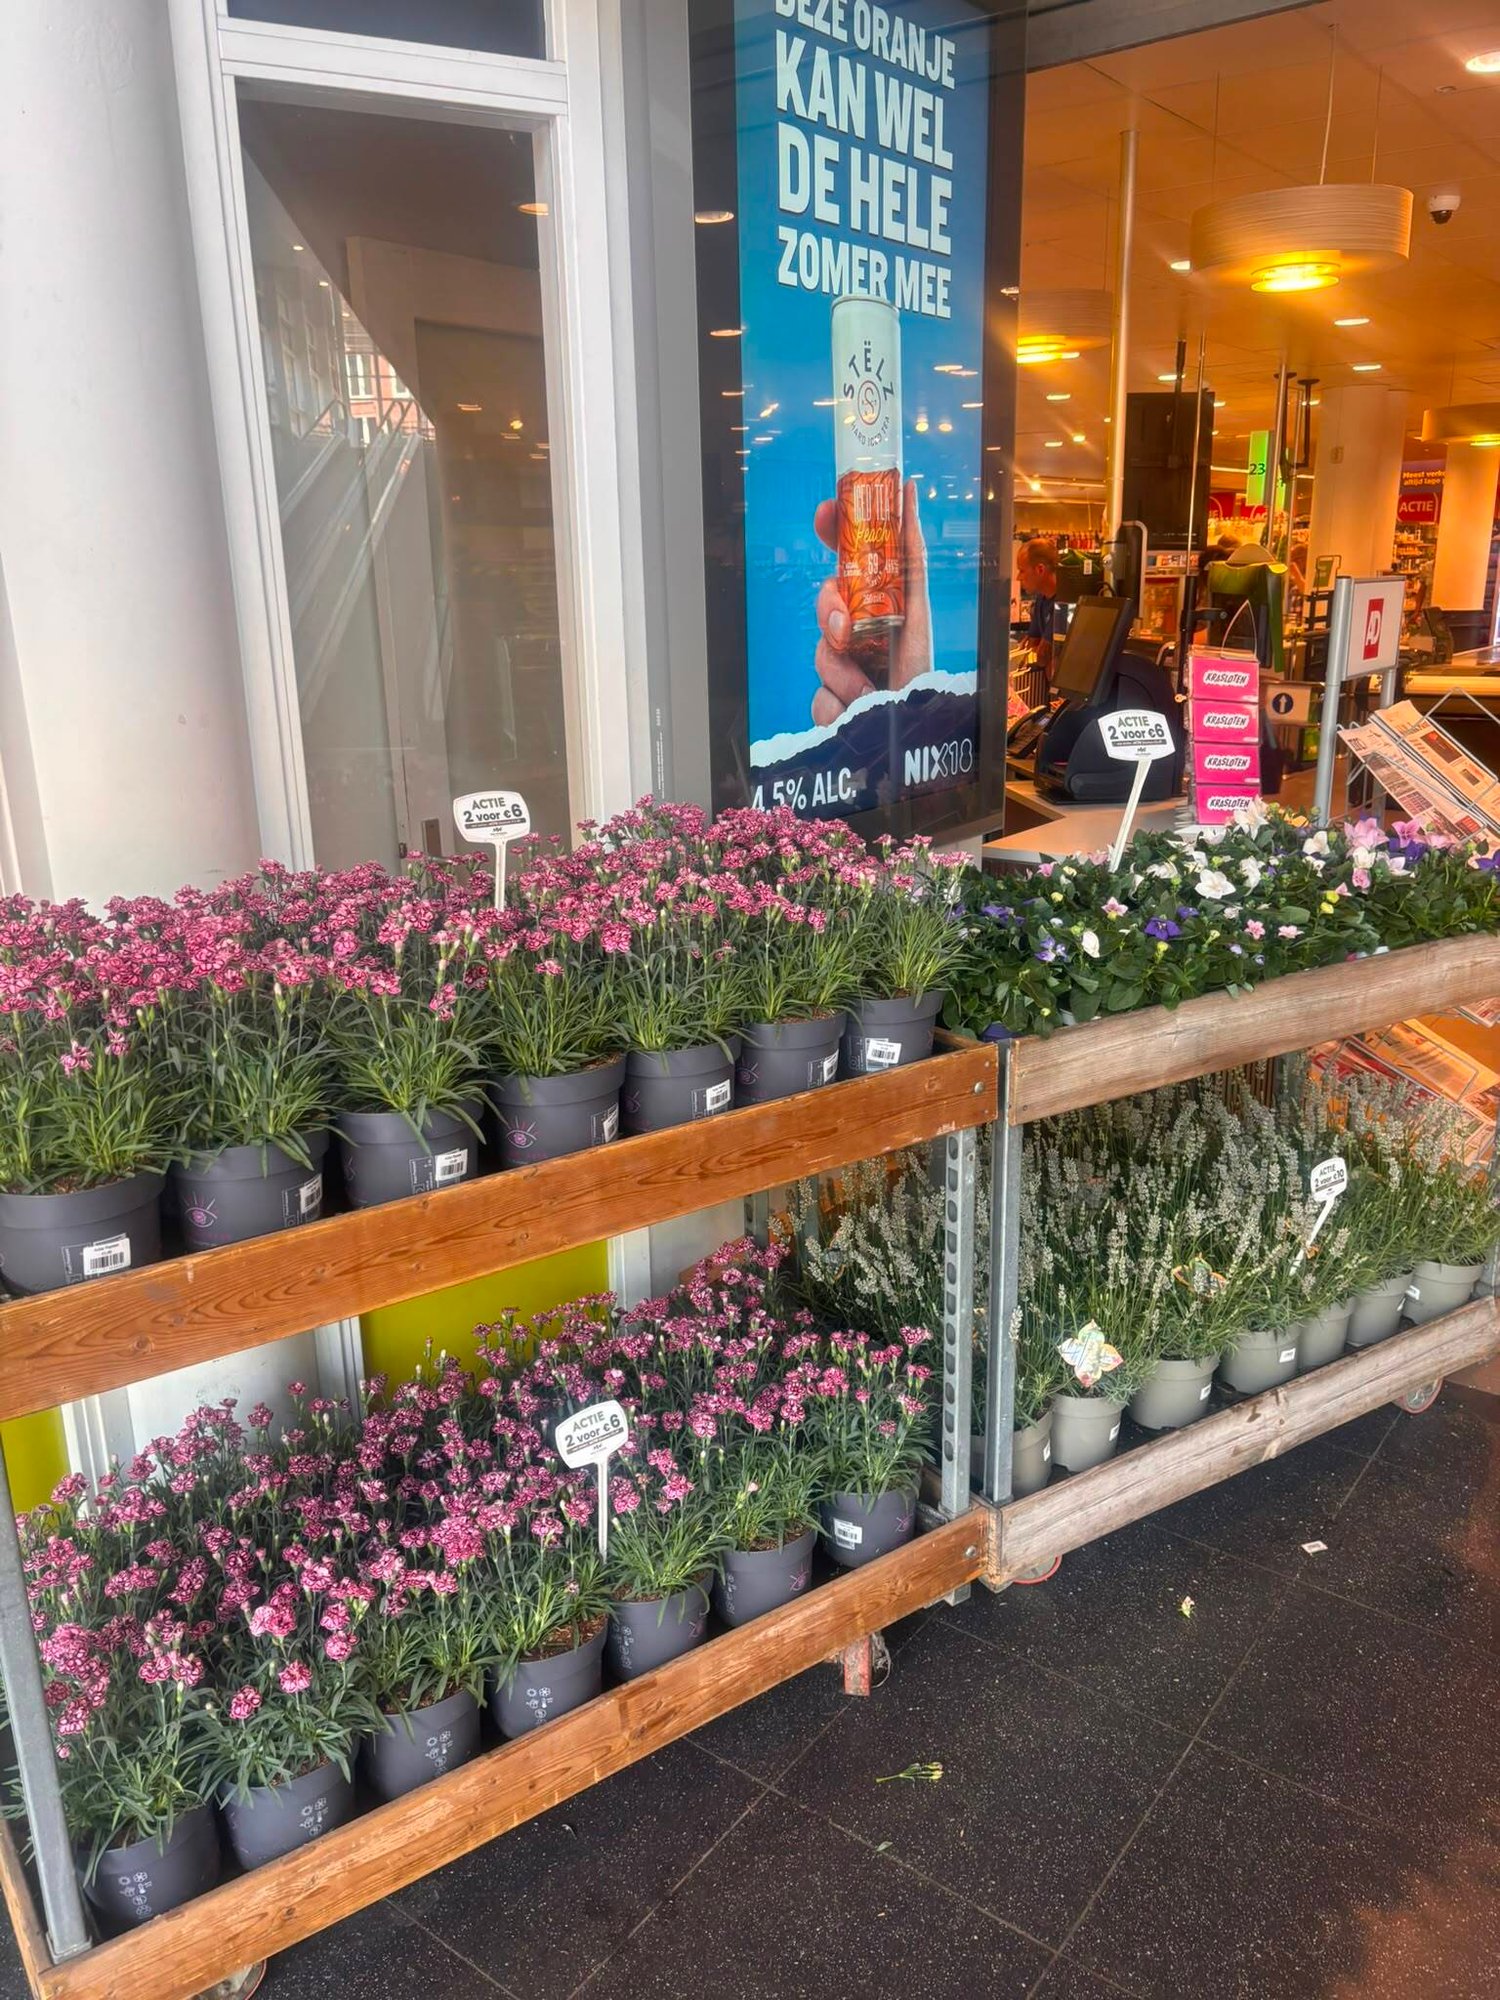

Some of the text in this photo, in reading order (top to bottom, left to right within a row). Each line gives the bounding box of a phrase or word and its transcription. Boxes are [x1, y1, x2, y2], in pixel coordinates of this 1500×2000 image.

[853, 0, 956, 90] ORANJE
[775, 29, 953, 171] KAN WEL
[778, 121, 952, 256] DE HELE
[778, 225, 952, 319] ZOMER MEE
[1249, 463, 1266, 475] 23
[1399, 500, 1434, 513] ACTIE
[1205, 672, 1247, 685] KRASLOTEN
[1118, 716, 1150, 728] ACTIE
[1205, 714, 1247, 727] KRASLOTEN
[1107, 725, 1119, 740] 2
[1120, 730, 1146, 740] voor
[904, 738, 973, 786] NIX18
[1207, 756, 1248, 768] KRASLOTEN
[812, 767, 857, 808] ALC.
[471, 797, 506, 810] ACTIE
[1209, 797, 1251, 809] KRASLOTEN
[463, 810, 474, 823] 2
[476, 812, 501, 822] voor
[572, 1411, 605, 1432] ACTIE
[565, 1434, 576, 1448] 2
[577, 1430, 599, 1442] voor
